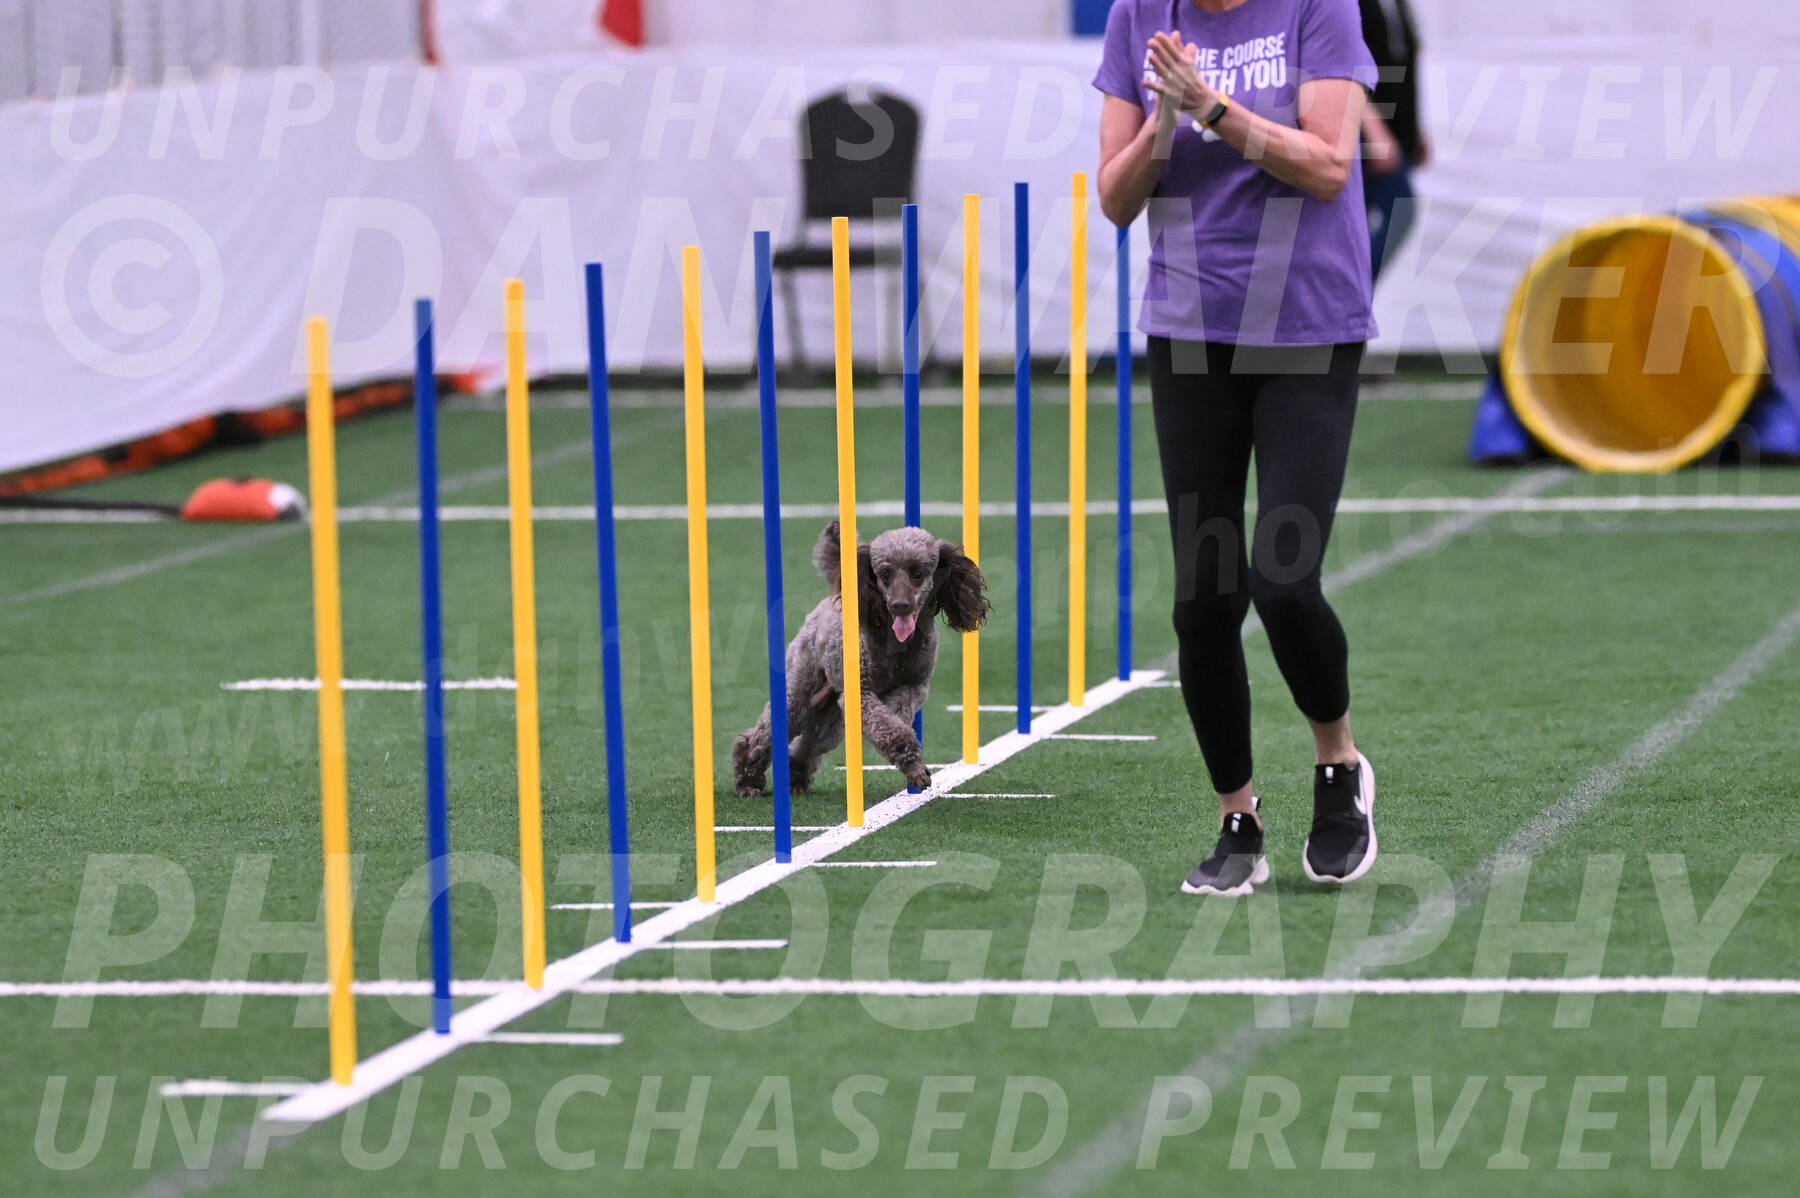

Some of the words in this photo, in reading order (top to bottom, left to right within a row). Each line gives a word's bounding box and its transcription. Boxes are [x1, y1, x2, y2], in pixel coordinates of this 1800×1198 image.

[1195, 47, 1219, 69] HE
[1222, 31, 1286, 69] COURSE
[1200, 69, 1237, 96] ITH
[1243, 56, 1287, 92] YOU
